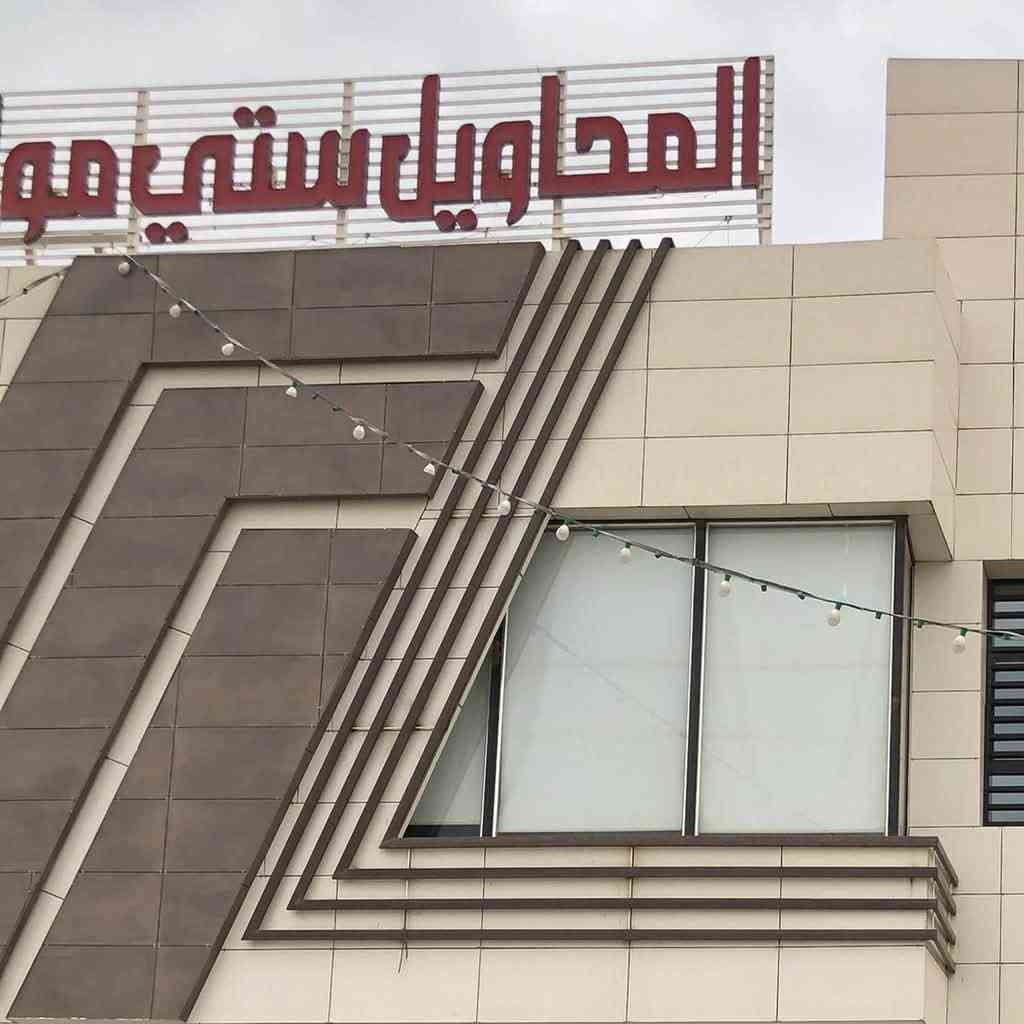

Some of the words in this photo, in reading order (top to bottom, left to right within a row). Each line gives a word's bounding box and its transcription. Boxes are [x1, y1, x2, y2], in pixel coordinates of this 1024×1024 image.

[0, 139, 119, 244] مو
[130, 105, 370, 244] ستي
[380, 56, 761, 231] المحاويل
